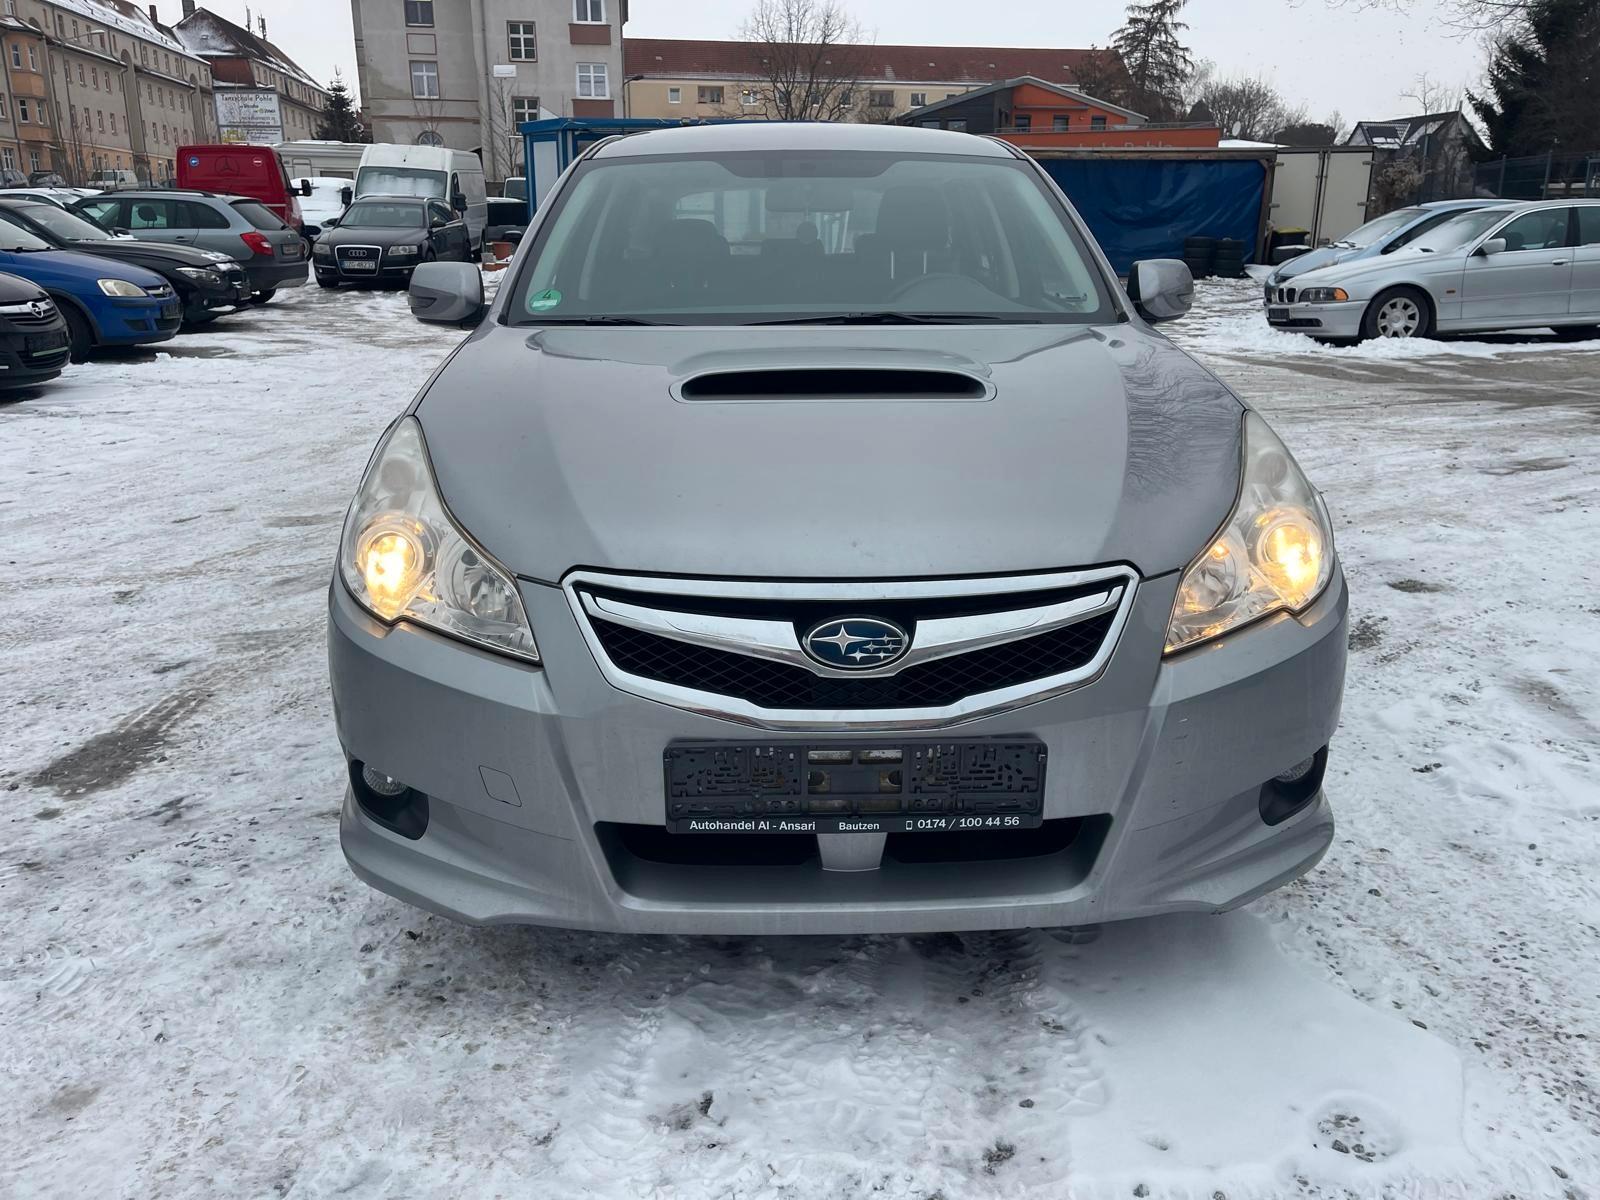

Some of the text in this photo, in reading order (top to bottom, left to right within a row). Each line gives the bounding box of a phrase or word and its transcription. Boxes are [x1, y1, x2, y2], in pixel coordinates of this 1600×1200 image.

[542, 289, 552, 299] 4
[689, 820, 755, 831] Autohandel
[758, 820, 770, 831] Al
[779, 821, 816, 831] Ansari
[838, 821, 880, 831] Bautzen
[917, 819, 947, 829] 0174
[948, 818, 957, 830] /
[959, 817, 983, 828] 100
[985, 816, 1001, 827] 44
[1004, 816, 1020, 826] 56
